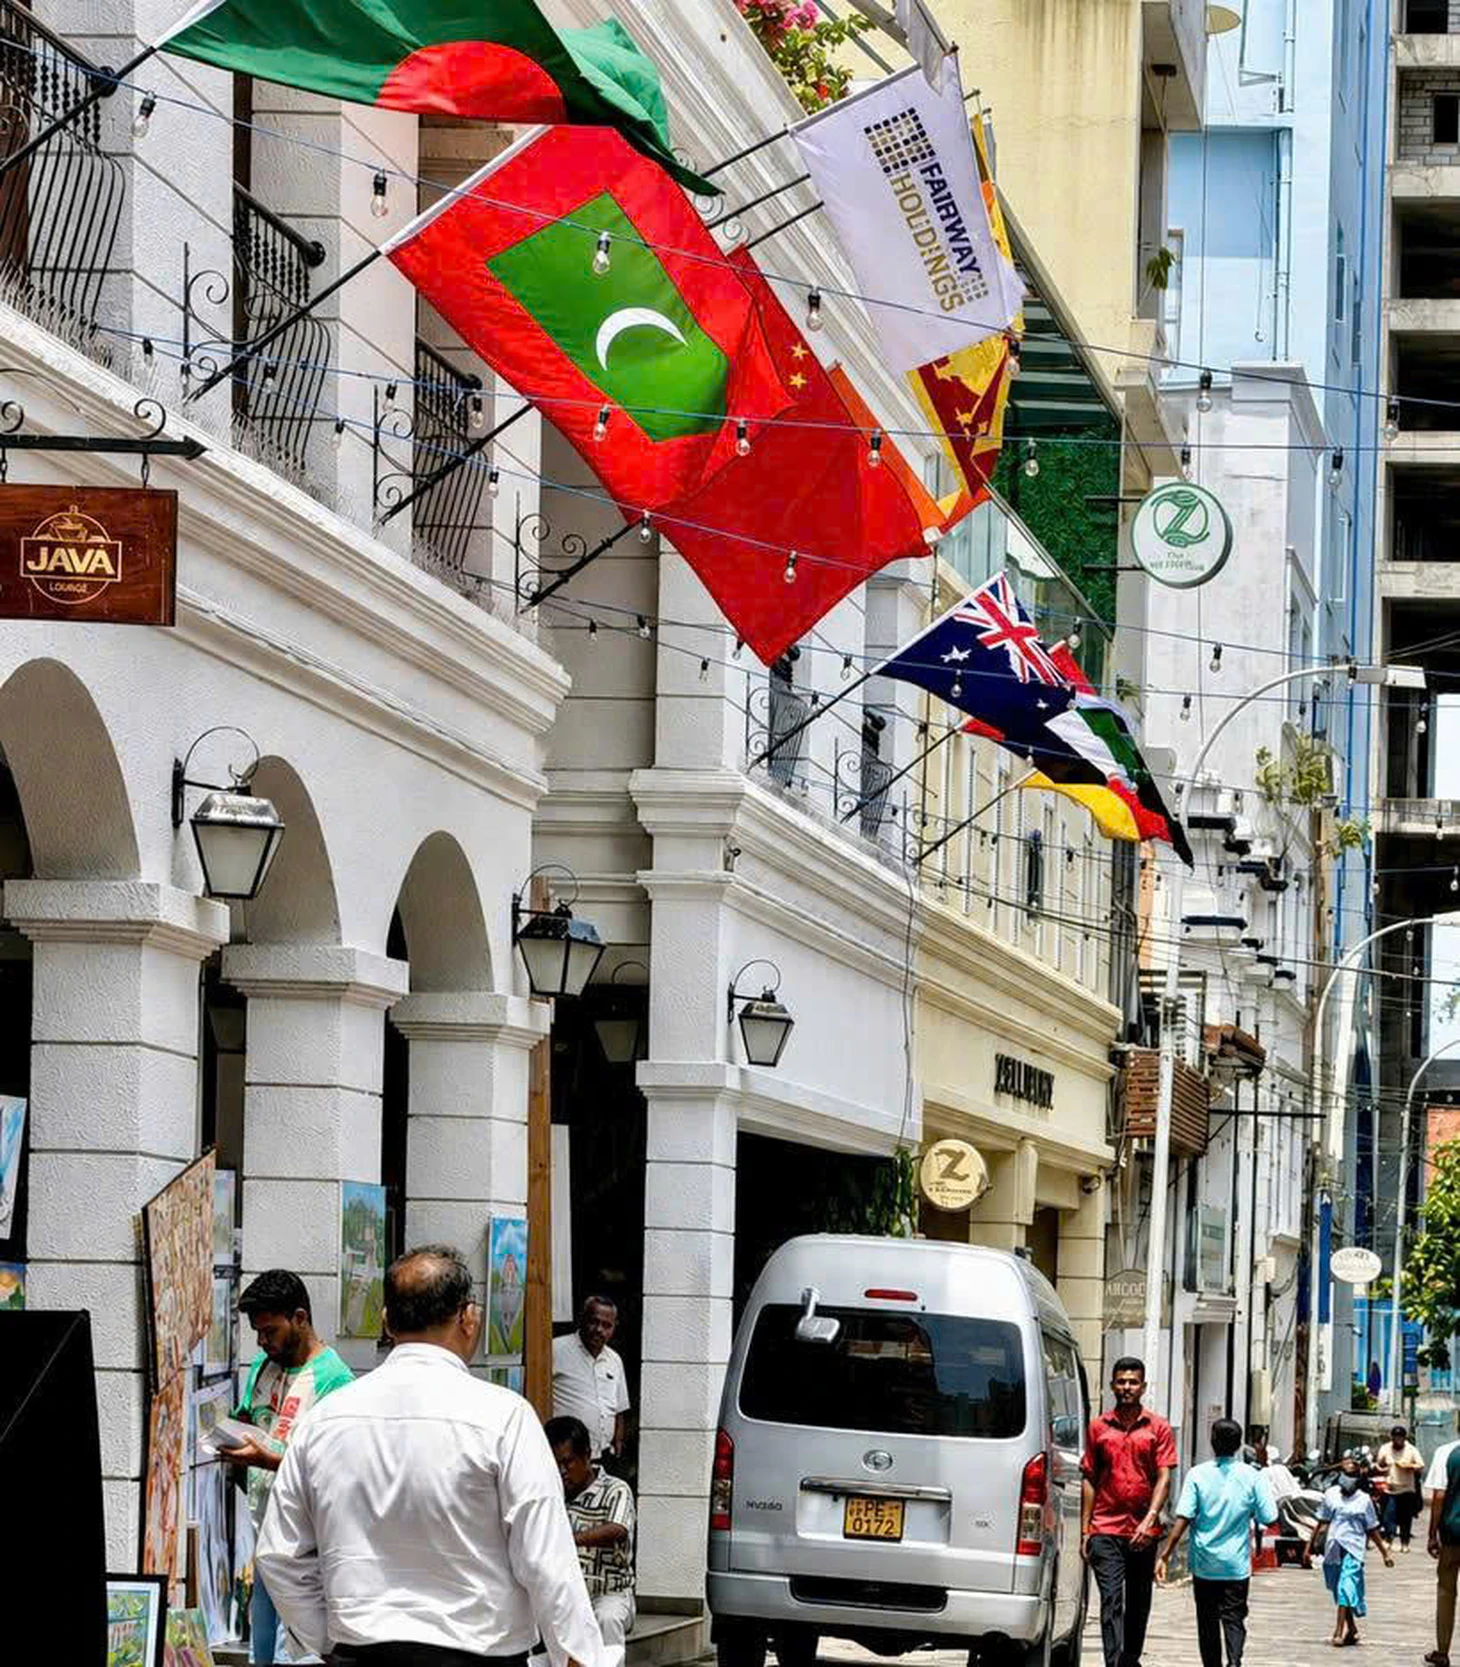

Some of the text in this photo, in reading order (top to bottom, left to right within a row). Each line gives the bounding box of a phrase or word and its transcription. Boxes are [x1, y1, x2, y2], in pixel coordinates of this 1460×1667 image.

[919, 161, 981, 279] FAIRWAY
[888, 171, 965, 314] HOLDINGS
[26, 546, 116, 575] JAVA
[49, 582, 88, 593] LOUNGE
[934, 1147, 970, 1181] Z
[863, 1500, 886, 1518] PE
[852, 1517, 895, 1536] 0172
